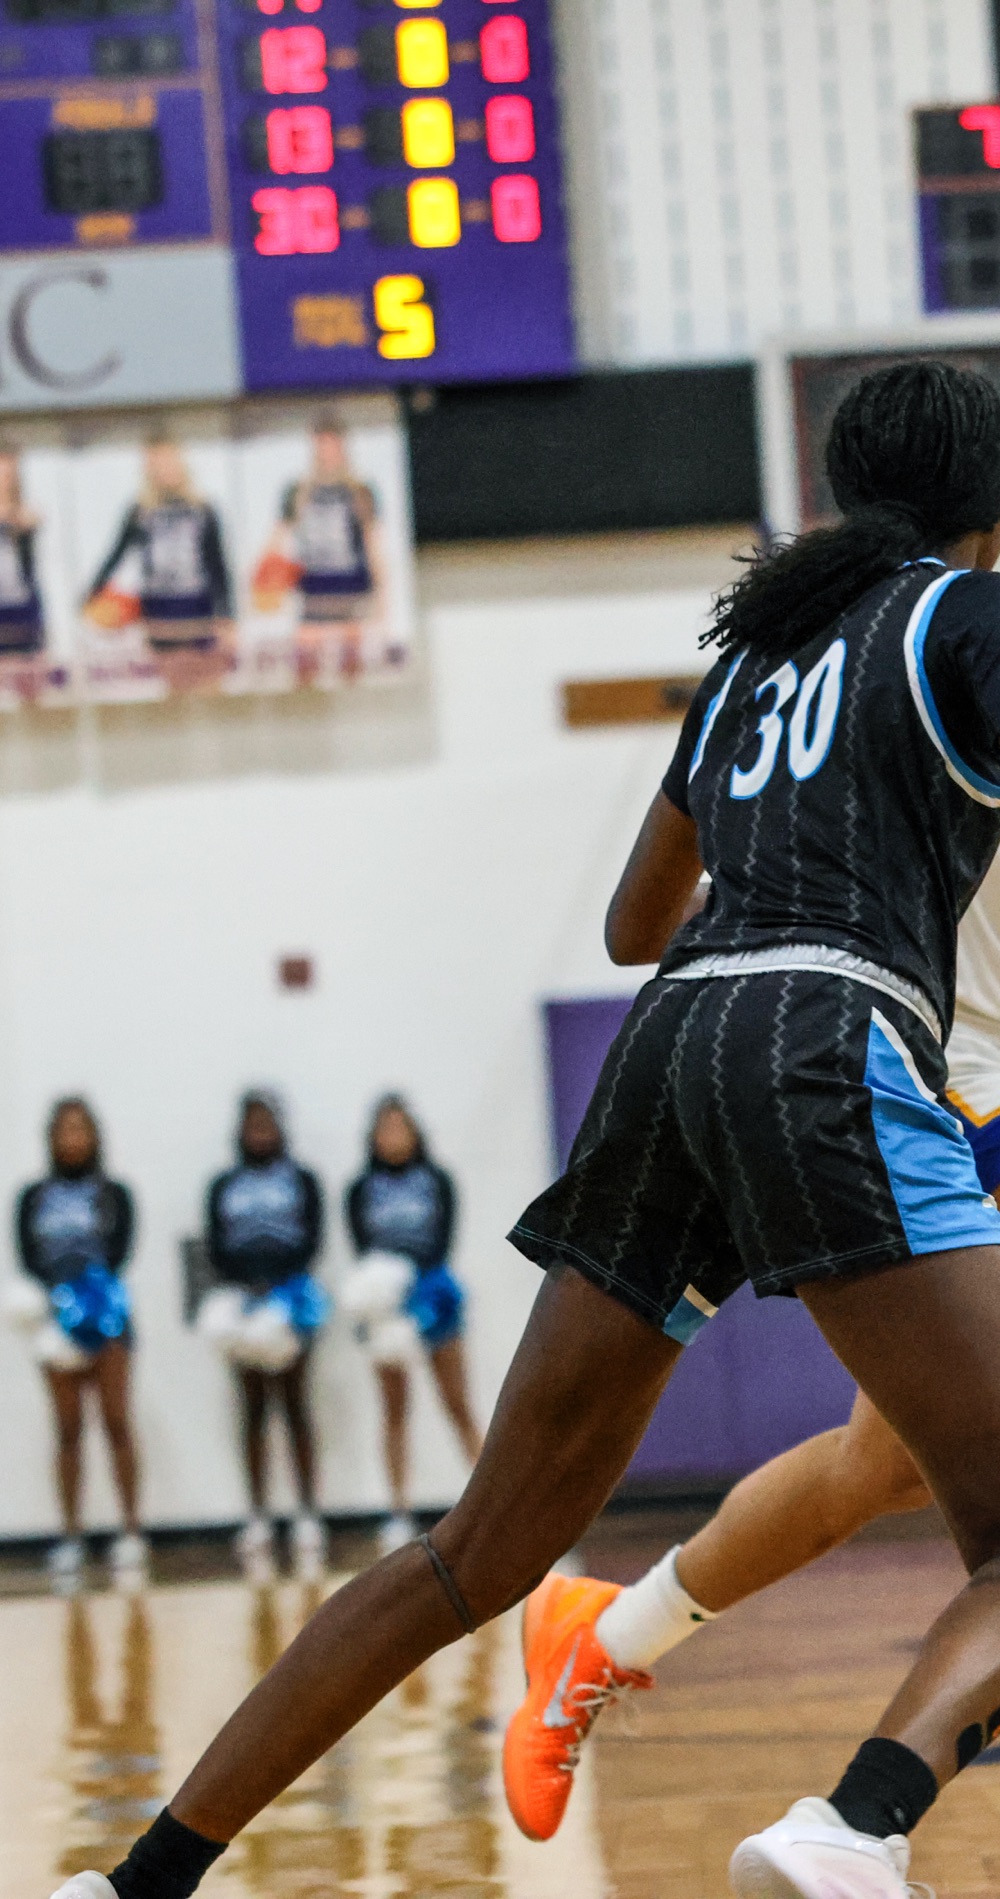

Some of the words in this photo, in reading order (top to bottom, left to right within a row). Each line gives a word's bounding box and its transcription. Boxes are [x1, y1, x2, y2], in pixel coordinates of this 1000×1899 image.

[260, 26, 328, 94] 12
[481, 15, 529, 83] 0
[486, 95, 535, 163] 0
[491, 174, 541, 243] 0
[0, 267, 124, 393] C
[373, 273, 435, 360] 5
[729, 637, 847, 800] 30
